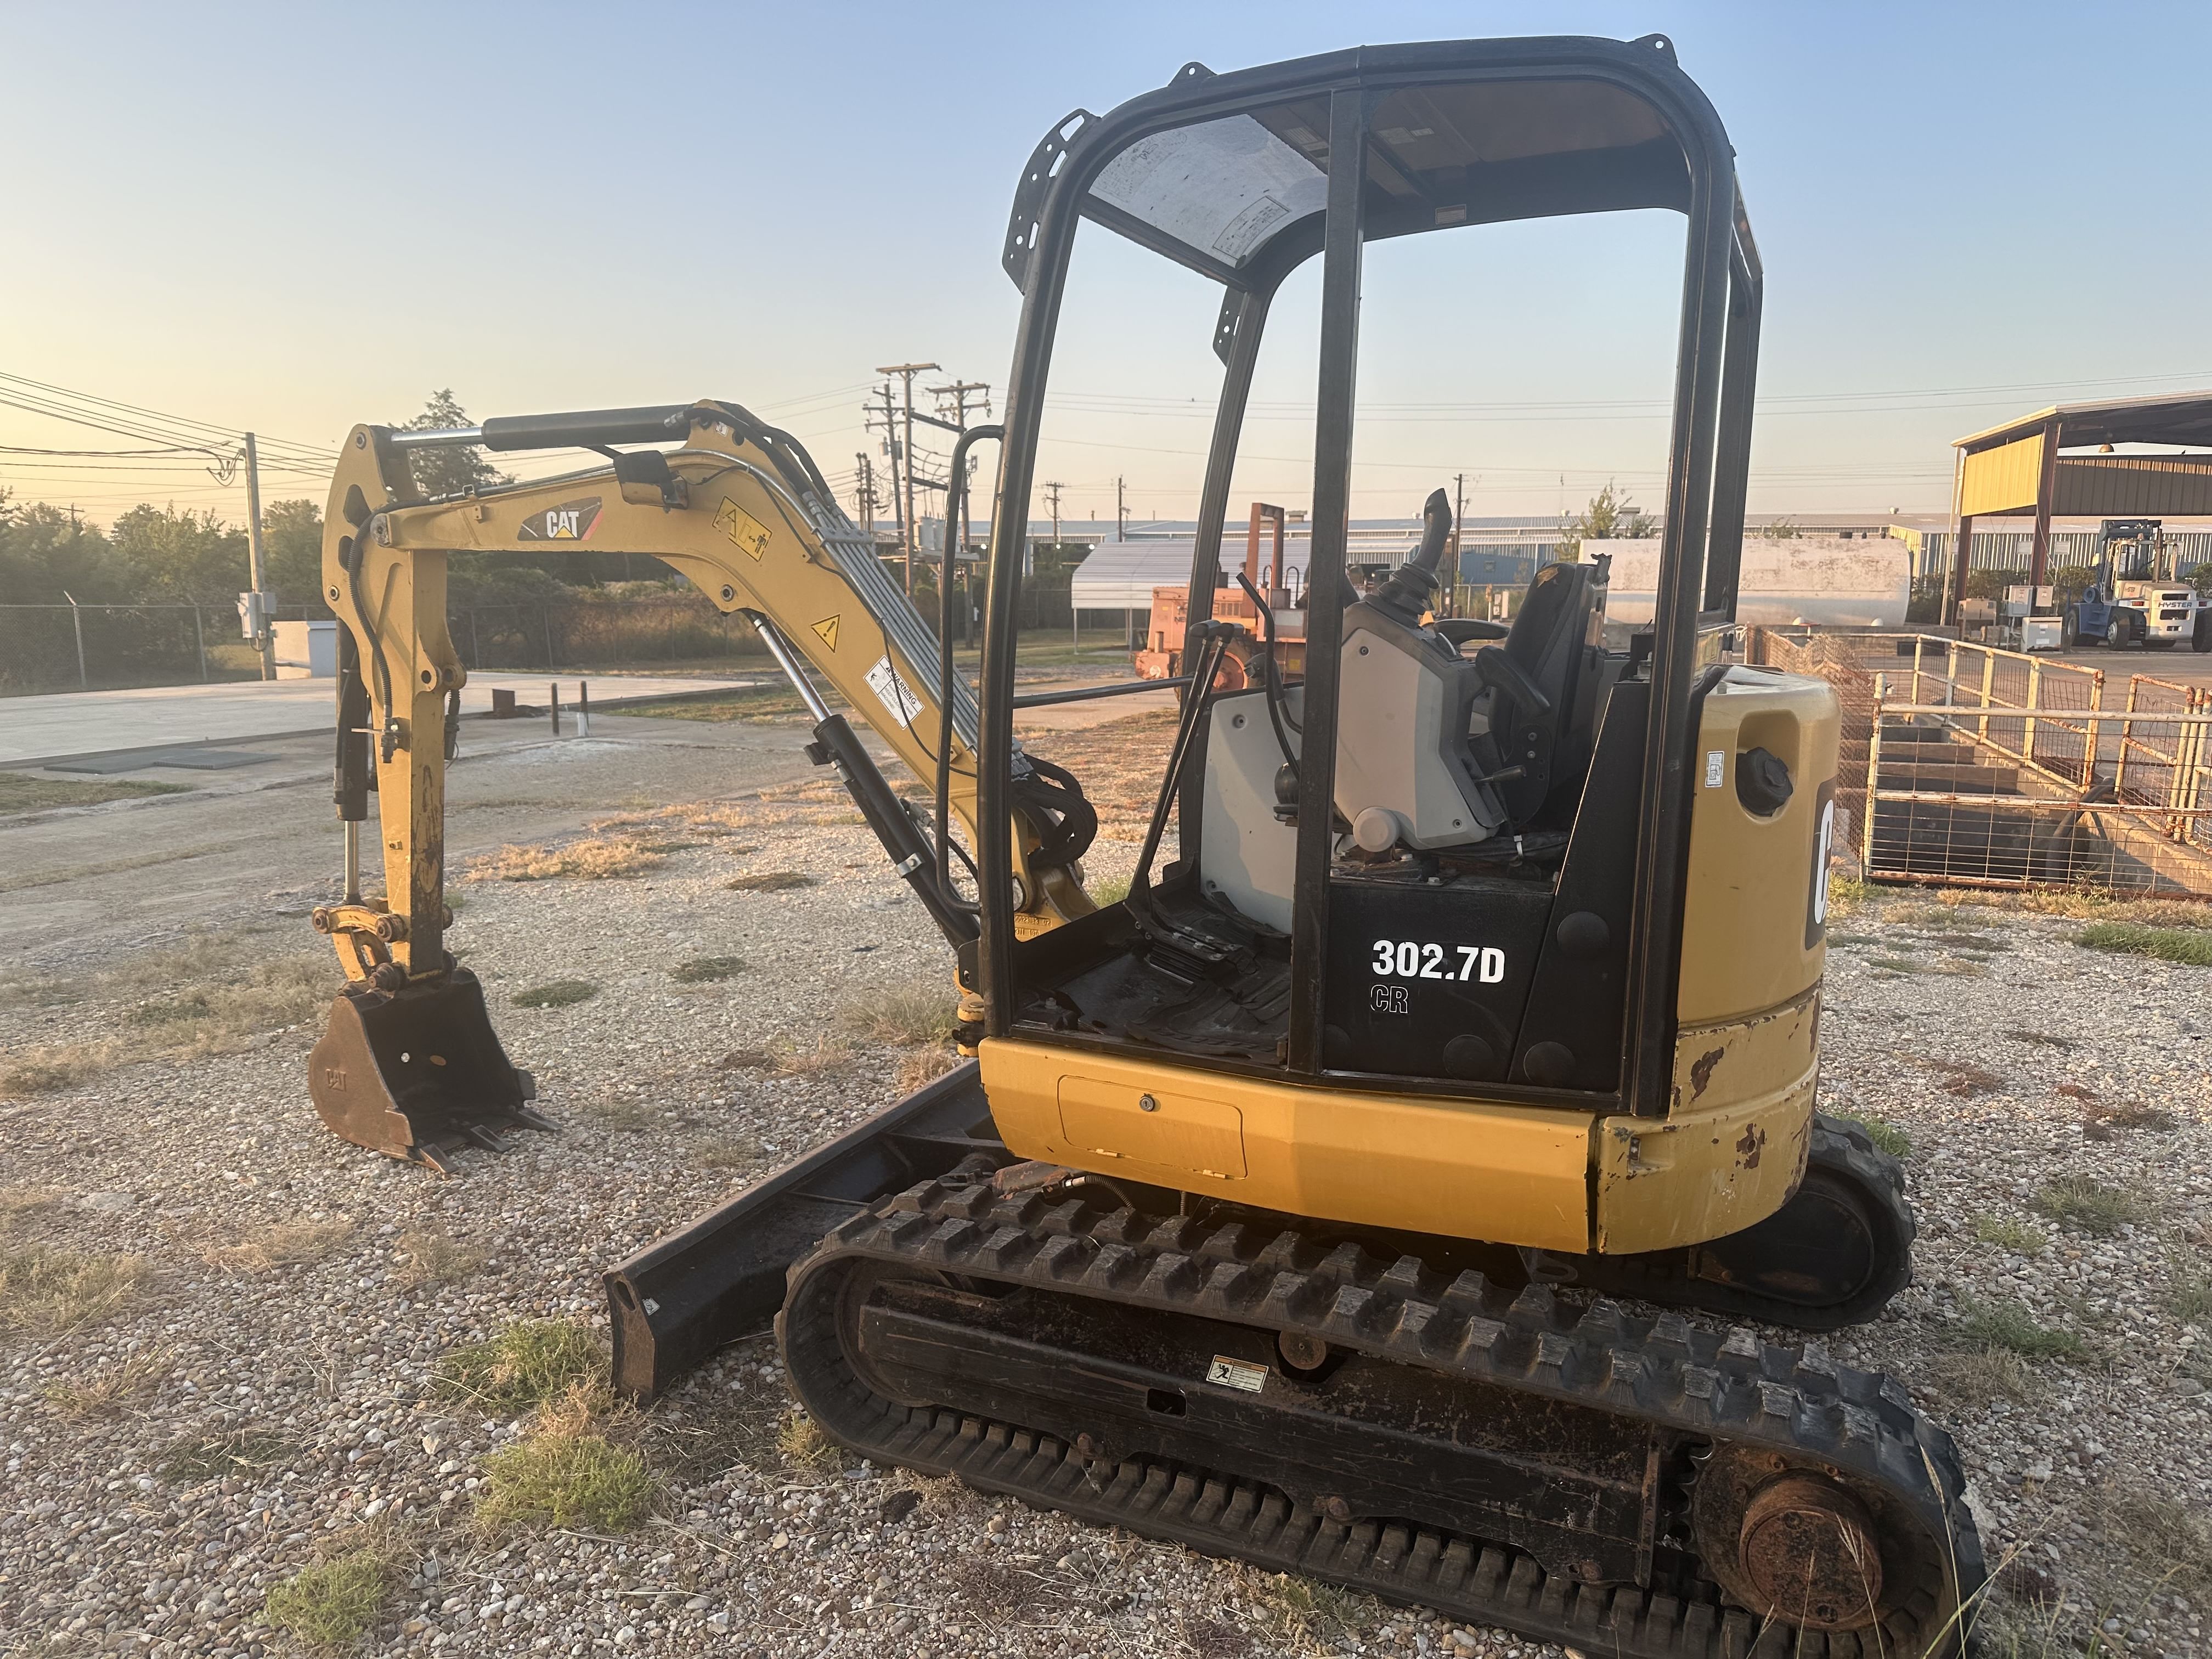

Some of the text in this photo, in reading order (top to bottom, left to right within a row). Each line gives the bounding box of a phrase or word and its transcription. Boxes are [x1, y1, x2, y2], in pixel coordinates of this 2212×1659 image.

[546, 511, 579, 538] CAT
[1372, 939, 1505, 984] 302.7D
[1370, 984, 1408, 1014] CR
[325, 1068, 347, 1092] CAT
